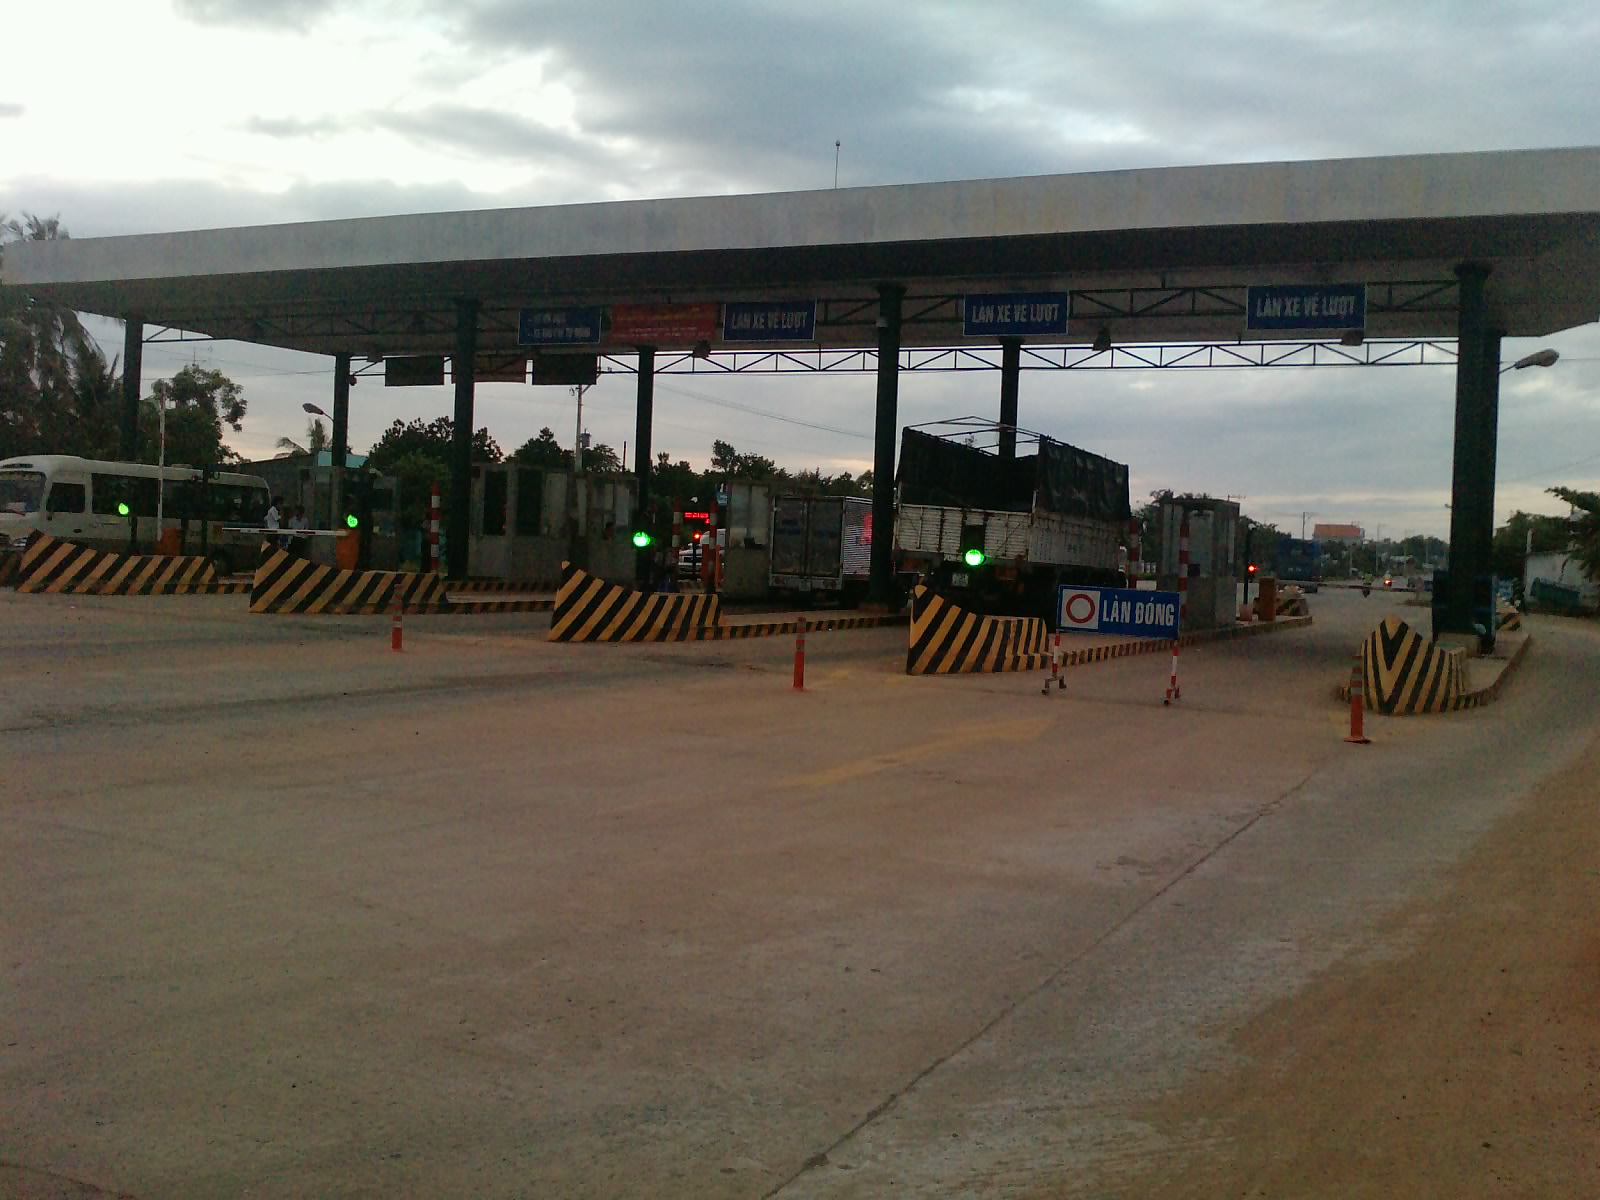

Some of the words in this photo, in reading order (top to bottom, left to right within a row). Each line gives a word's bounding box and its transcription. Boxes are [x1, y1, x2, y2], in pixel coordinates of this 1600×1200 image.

[997, 303, 1011, 323] XE
[1256, 292, 1281, 317] LÀN
[1283, 295, 1301, 317] XE
[1102, 594, 1131, 624] LÀN
[1135, 596, 1175, 627] ĐÓNG
